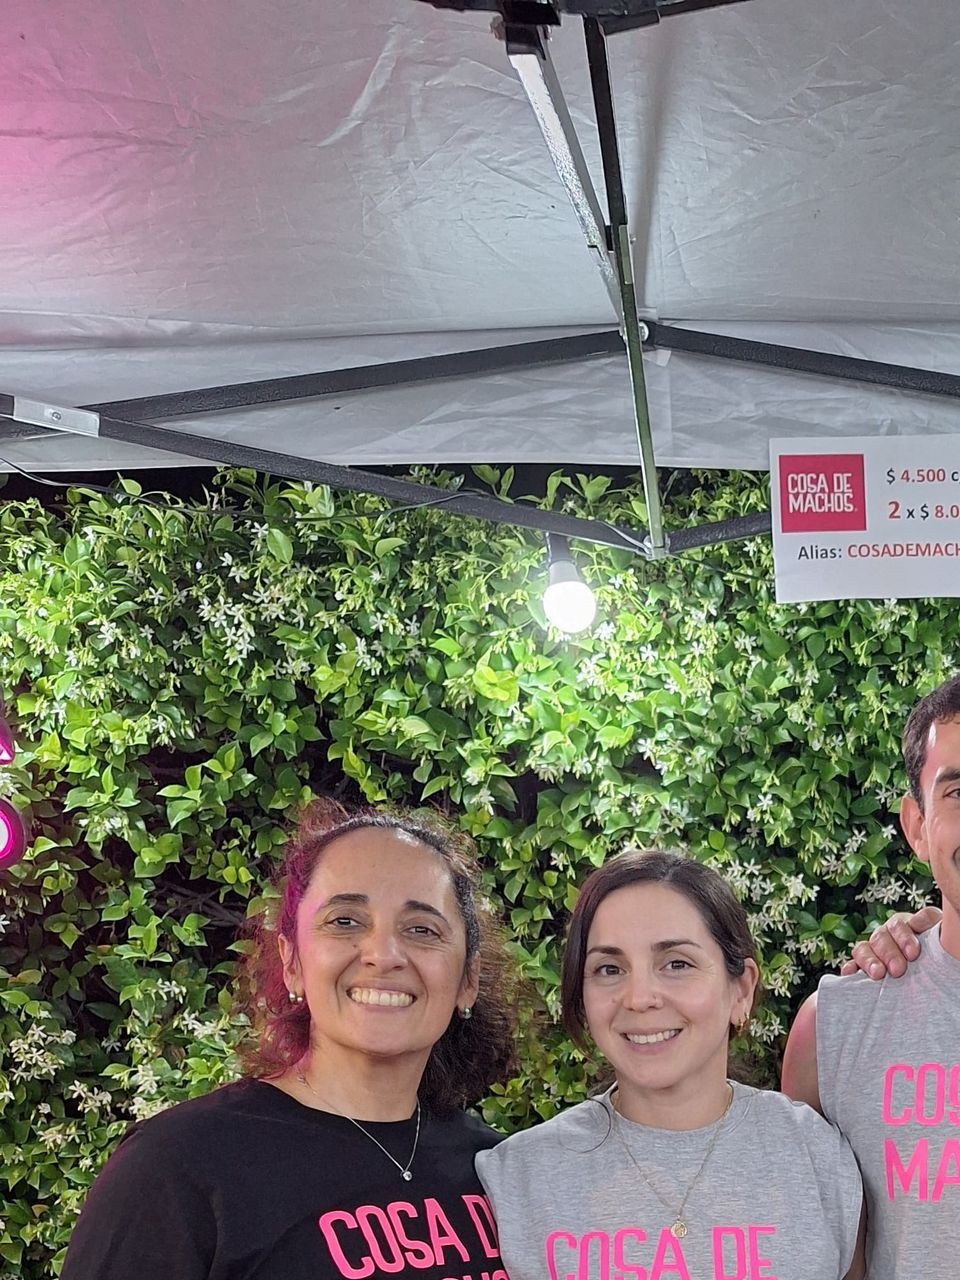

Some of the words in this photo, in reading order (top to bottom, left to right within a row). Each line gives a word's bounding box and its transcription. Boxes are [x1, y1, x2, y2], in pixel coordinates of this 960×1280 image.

[787, 473, 829, 493] COSA
[834, 473, 852, 493] DE
[886, 467, 895, 484] $
[900, 468, 946, 483] 4.500
[888, 501, 901, 519] 2
[906, 507, 915, 518] x
[920, 503, 929, 521] $
[798, 545, 842, 561] Alias:
[318, 1198, 471, 1280] COSA
[461, 1194, 499, 1259] D
